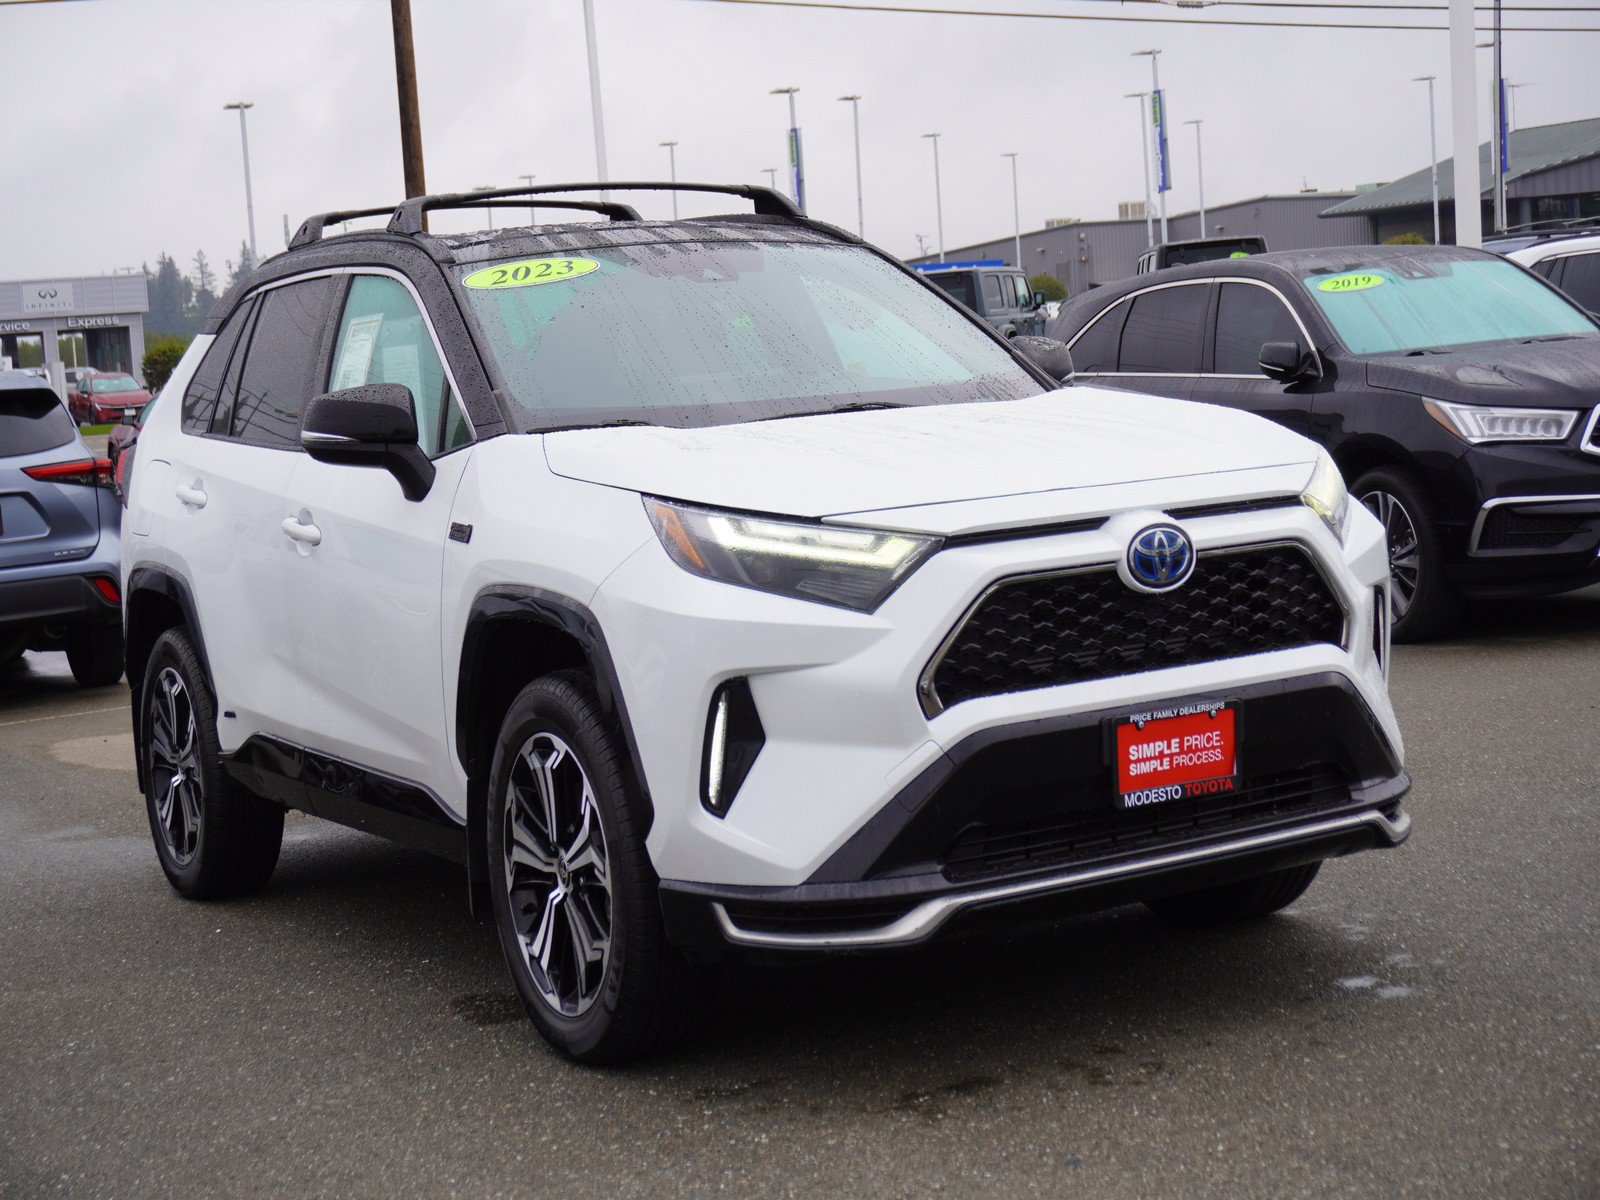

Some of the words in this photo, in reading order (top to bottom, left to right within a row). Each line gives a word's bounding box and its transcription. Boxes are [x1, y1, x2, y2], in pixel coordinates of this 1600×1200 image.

[490, 260, 574, 285] 2023
[1331, 275, 1371, 290] 2019
[26, 301, 72, 310] INFINITI
[67, 316, 119, 328] Express
[1130, 713, 1152, 723] PRICE
[1153, 708, 1178, 719] FAMILY
[1180, 701, 1225, 715] DEALERSHIPS
[1129, 738, 1180, 760] SIMPLE
[1184, 731, 1224, 751] PRICE.
[1129, 757, 1170, 776] SIMPLE
[1173, 749, 1224, 768] PROCESS.
[1124, 785, 1182, 808] MODESTO
[1185, 778, 1233, 796] TOYOTA
